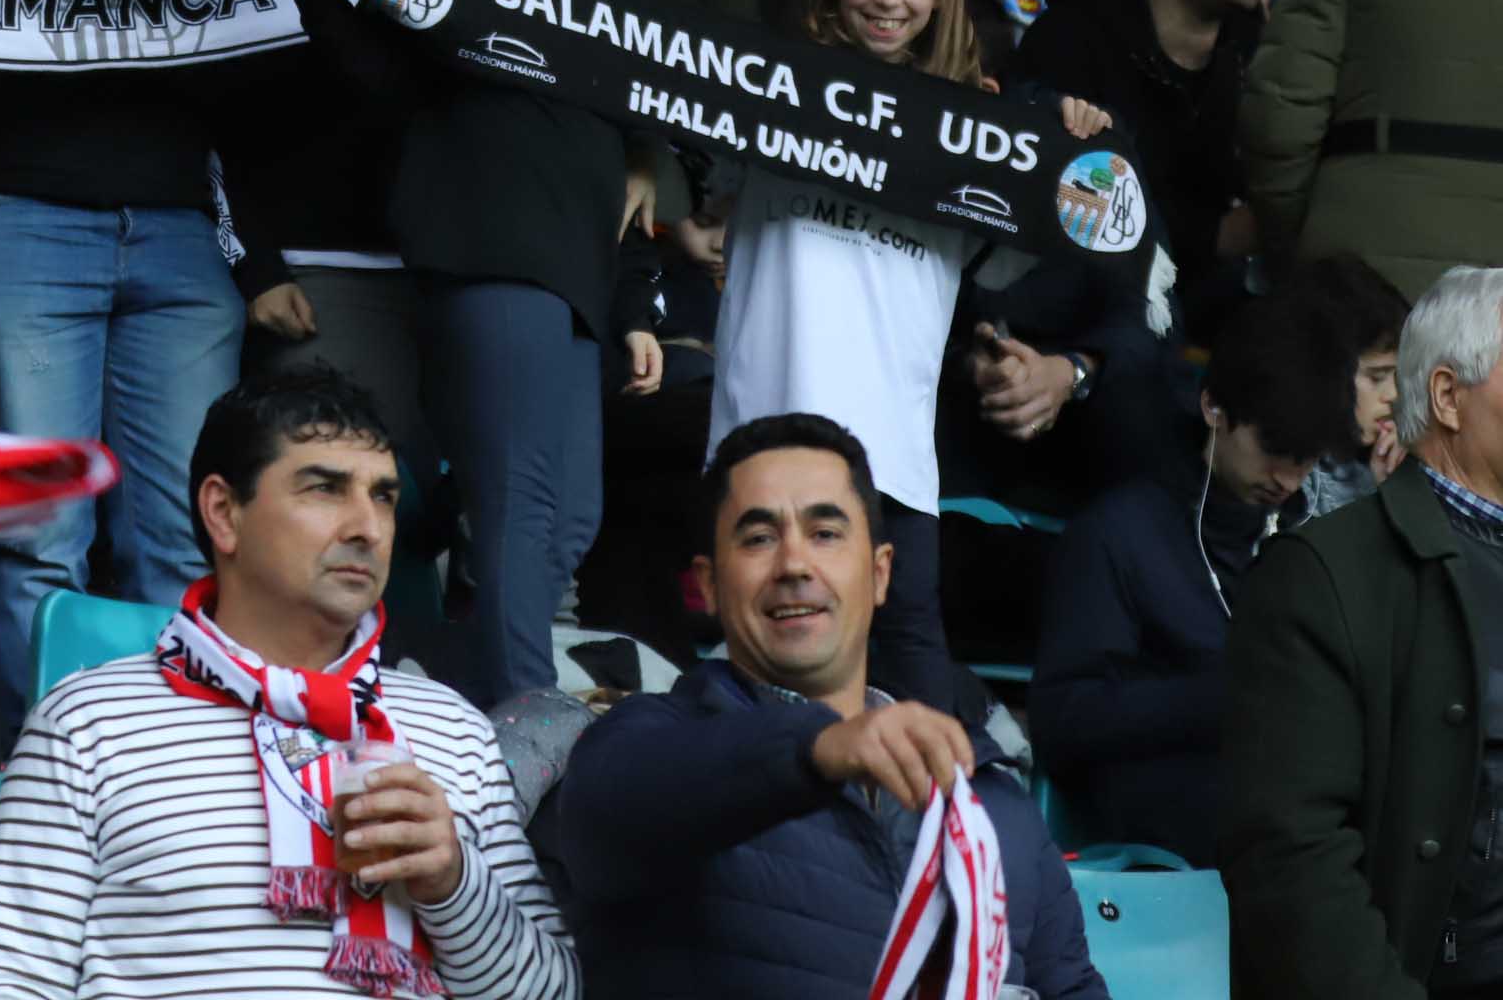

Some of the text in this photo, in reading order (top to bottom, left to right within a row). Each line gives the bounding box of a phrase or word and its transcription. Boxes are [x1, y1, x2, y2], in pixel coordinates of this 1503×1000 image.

[628, 81, 889, 192] ¡HALA, UNIÓN!
[823, 81, 904, 138] C.F.
[938, 111, 1041, 172] UDS
